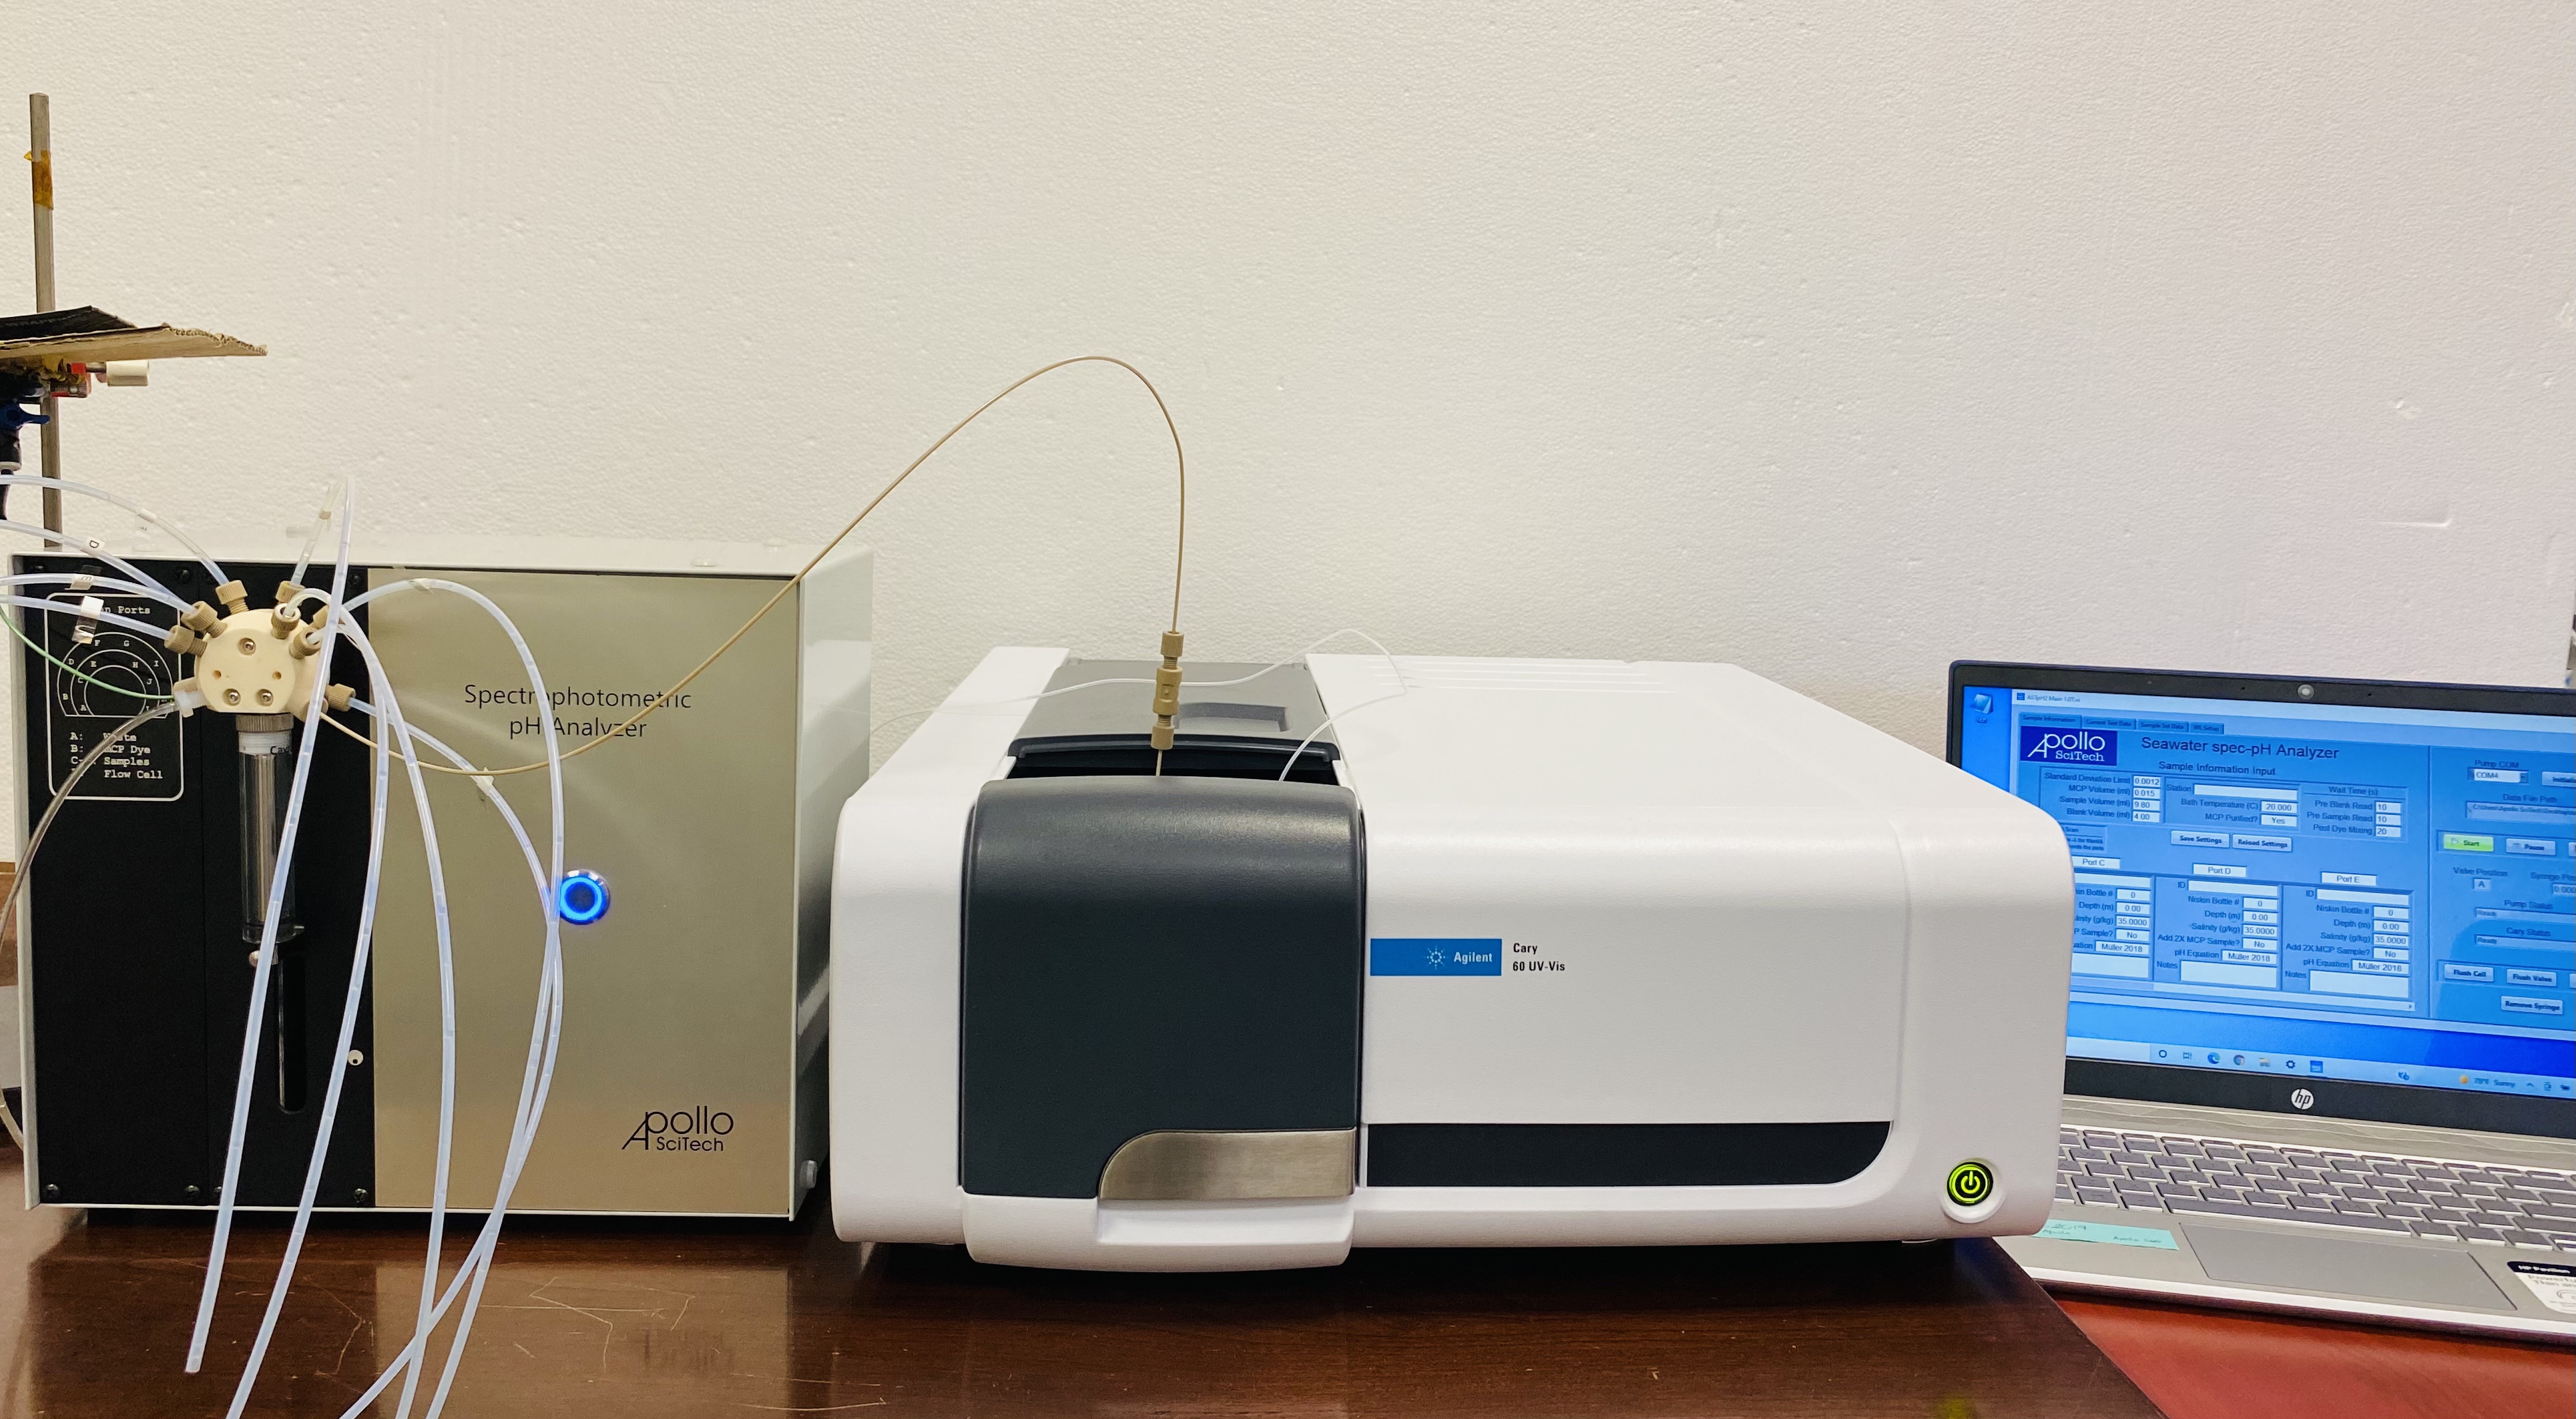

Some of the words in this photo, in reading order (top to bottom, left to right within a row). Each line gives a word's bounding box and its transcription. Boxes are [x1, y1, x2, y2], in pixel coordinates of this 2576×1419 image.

[89, 540, 99, 548] D
[117, 606, 150, 614] Ports
[465, 685, 692, 709] Spectrphotometric
[510, 717, 541, 739] pH
[70, 732, 83, 740] A:
[2028, 732, 2106, 758] Apollo
[2141, 737, 2208, 752] Seawater
[2212, 744, 2272, 756] spec-pH
[2276, 744, 2339, 760] Analyzer
[131, 746, 151, 756] Dye
[2056, 751, 2105, 762] SciTech
[104, 757, 150, 768] Samples
[2475, 760, 2497, 768] Pump
[2159, 761, 2194, 772] Sample
[2197, 764, 2250, 774] Information
[2252, 766, 2276, 776] Input
[104, 770, 131, 778] Flow
[137, 771, 163, 779] Cell
[2045, 772, 2077, 780] Standard
[2079, 774, 2111, 783] Deviation
[2089, 786, 2115, 794] Volume
[2167, 784, 2192, 792] Station
[2348, 787, 2366, 795] Time
[2059, 796, 2087, 804] Sample
[2088, 798, 2115, 806] Volume
[2200, 800, 2245, 809] Temperature
[2330, 801, 2350, 809] Blank
[2088, 810, 2115, 818] Volume
[2226, 814, 2258, 822] Purified?
[2322, 812, 2350, 822] Sample
[2314, 824, 2330, 832] Post
[2332, 825, 2346, 834] Dye
[2348, 826, 2373, 835] Mixing
[2196, 836, 2222, 844] Settings
[2476, 868, 2508, 876] Position
[2086, 888, 2107, 896] Bottle
[2188, 896, 2210, 904] Niskin
[2079, 901, 2099, 910] Depth
[2316, 904, 2339, 912] Niskin
[2205, 910, 2226, 918] Depth
[2093, 916, 2113, 924] (g/kg)
[2117, 918, 2147, 926] 35.0000
[2334, 919, 2356, 928] Depth
[2081, 928, 2113, 937] Sample?
[2192, 923, 2218, 932] Salinity
[2220, 925, 2240, 934] (g/kg)
[2506, 927, 2525, 936] Cary
[2320, 932, 2347, 942] Salinity
[2375, 936, 2406, 944] 35.0000
[2208, 938, 2240, 946] Sample?
[1513, 943, 1538, 954] Cary
[2316, 944, 2335, 952] MCP
[2337, 947, 2370, 956] Sample?
[1454, 952, 1493, 964] Agilent
[2187, 950, 2219, 959] Equation
[1513, 961, 1525, 971] 60
[1529, 961, 1565, 971] UV-Vis
[2316, 959, 2350, 968] Equation
[2382, 964, 2402, 972] 2018
[2284, 970, 2307, 978] Notes
[621, 1105, 734, 1150] Apollo
[657, 1137, 724, 1151] SciTech
